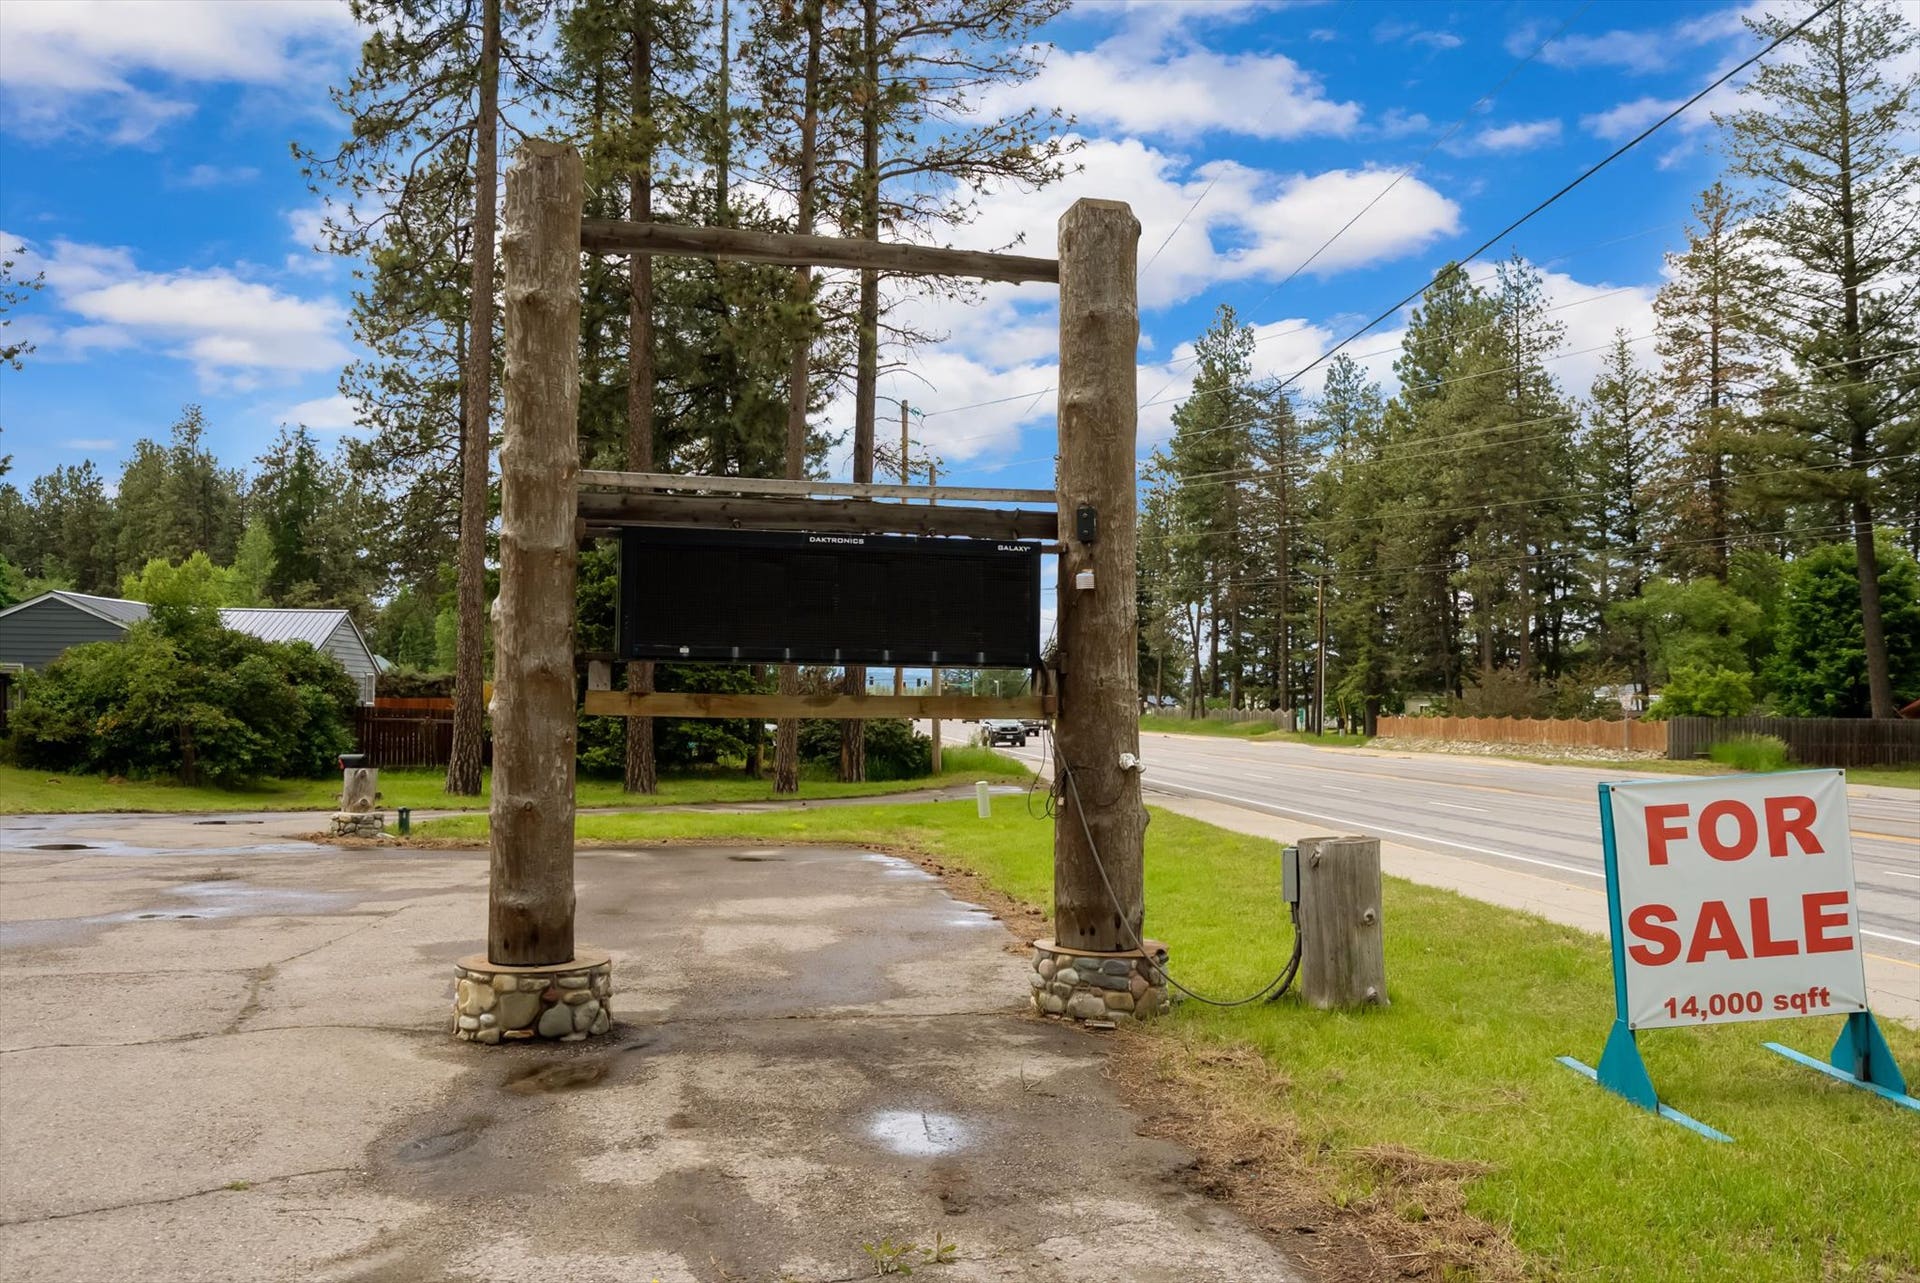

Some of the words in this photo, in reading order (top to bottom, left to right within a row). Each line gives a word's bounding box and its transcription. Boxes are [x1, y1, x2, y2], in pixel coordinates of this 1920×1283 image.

[809, 536, 865, 545] DAKTRONICS
[997, 544, 1029, 552] GALAXY
[1644, 795, 1825, 866] FOR
[1627, 890, 1854, 967] SALE
[1663, 990, 1763, 1022] 14,000
[1773, 986, 1831, 1015] sqft
